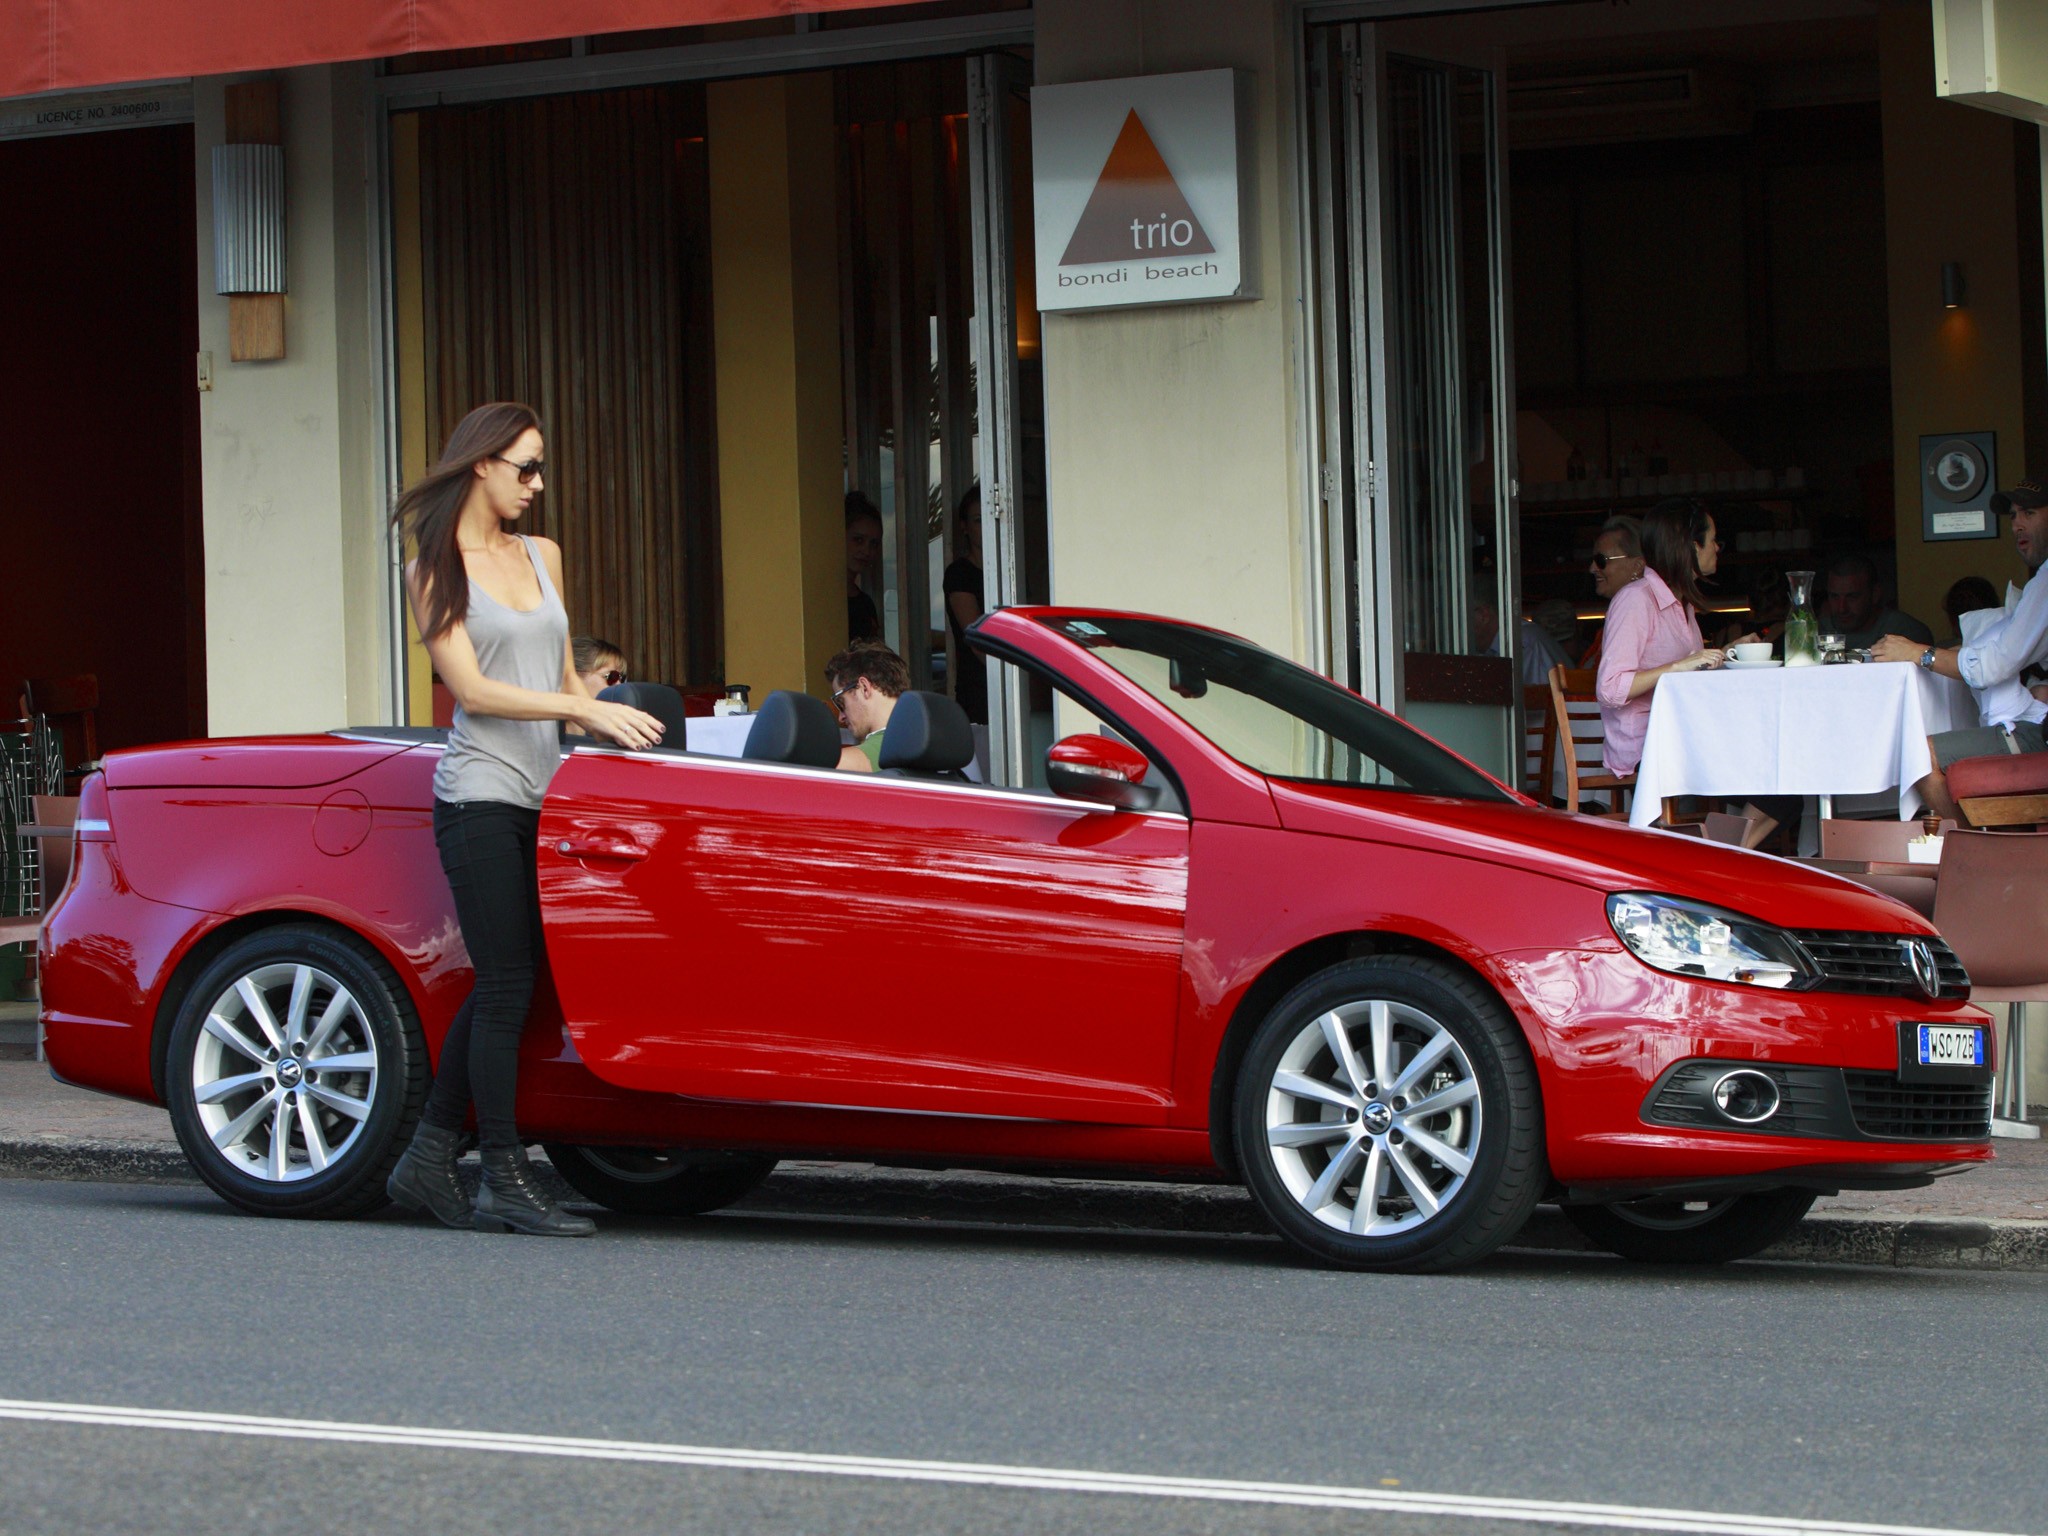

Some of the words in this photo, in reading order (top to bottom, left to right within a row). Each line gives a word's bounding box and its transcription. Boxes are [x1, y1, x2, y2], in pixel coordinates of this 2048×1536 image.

[37, 109, 83, 124] LICENCE
[1130, 212, 1193, 250] trio
[1058, 268, 1128, 287] bondi
[1145, 261, 1218, 280] beach
[1931, 1032, 1953, 1058] WSC
[1956, 1034, 1974, 1059] 72B
